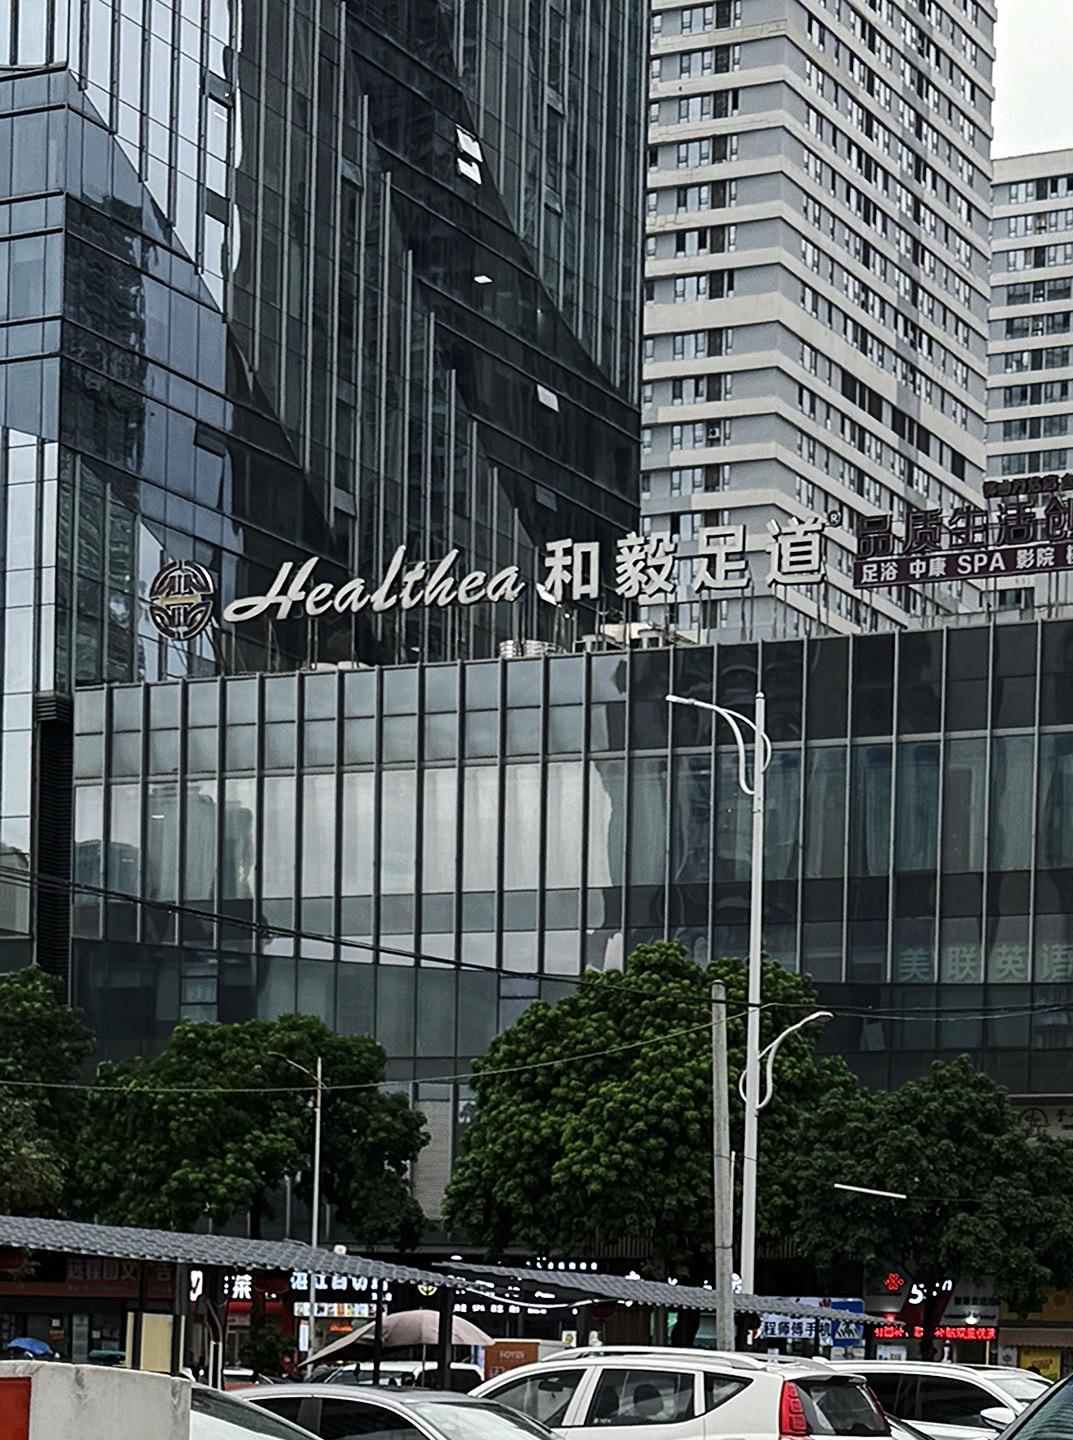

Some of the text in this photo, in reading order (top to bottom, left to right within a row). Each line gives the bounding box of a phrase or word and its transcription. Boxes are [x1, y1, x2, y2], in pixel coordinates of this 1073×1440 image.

[223, 516, 828, 624] Healthea 和毅足道
[861, 562, 898, 584] 足浴
[957, 552, 1006, 574] SPA
[1016, 547, 1056, 569] 影院
